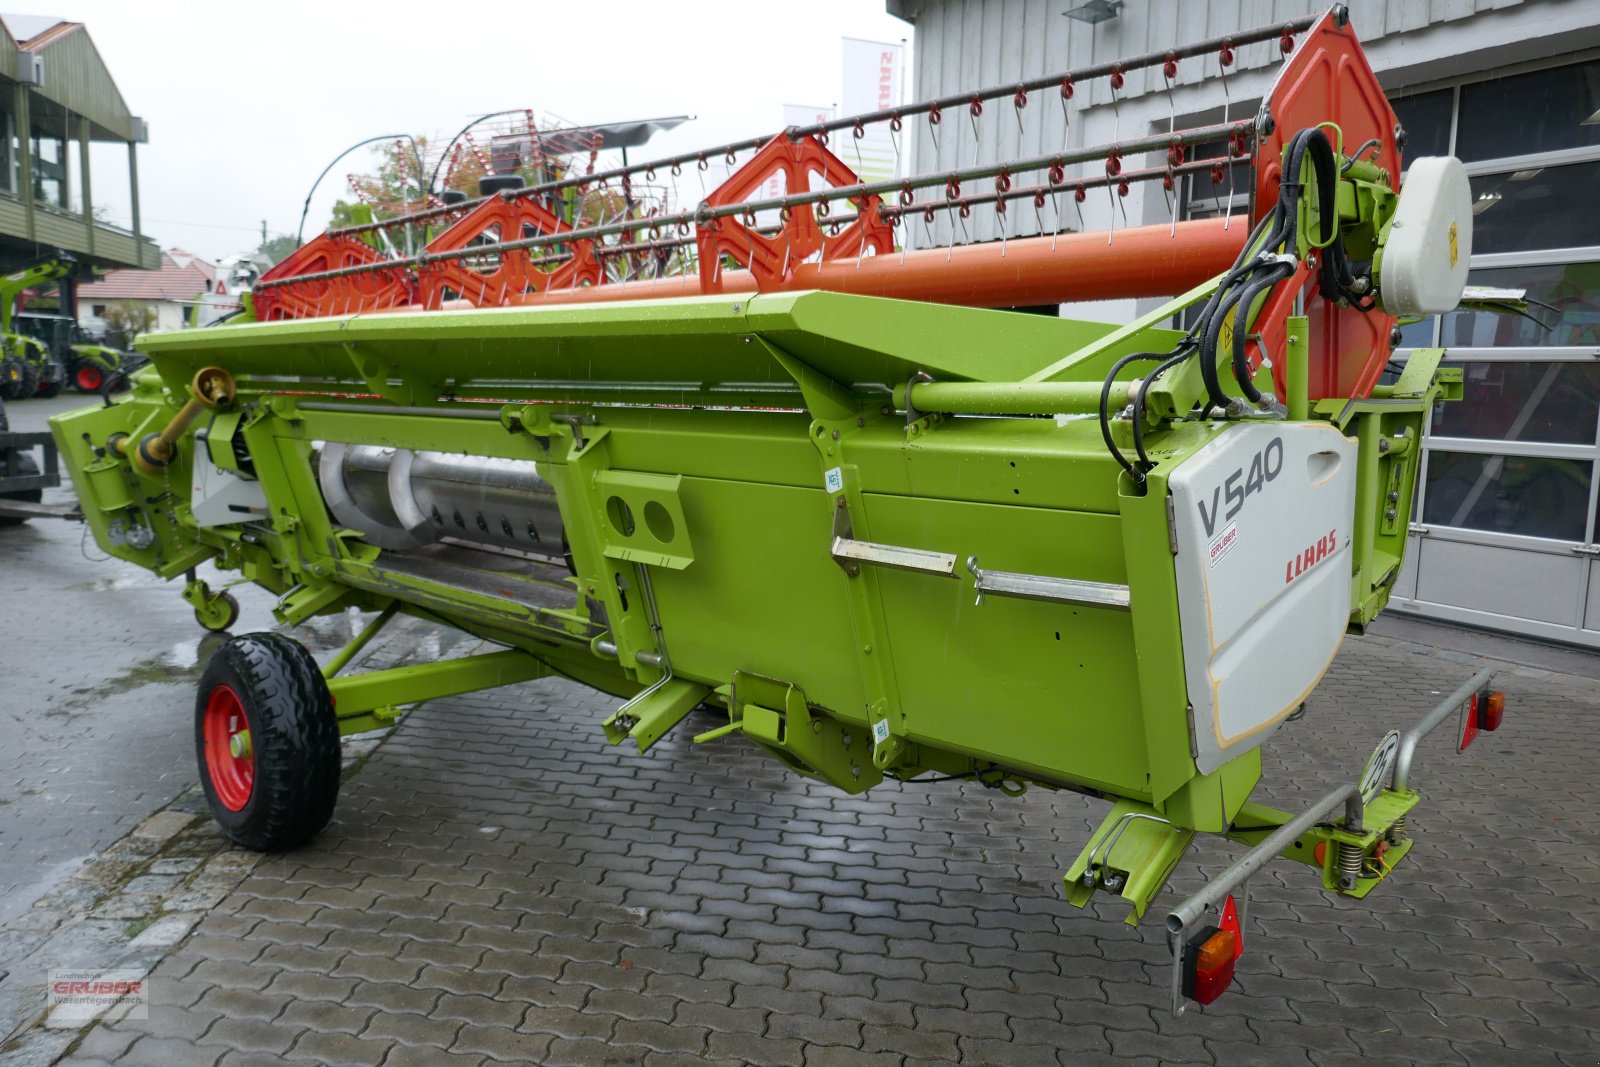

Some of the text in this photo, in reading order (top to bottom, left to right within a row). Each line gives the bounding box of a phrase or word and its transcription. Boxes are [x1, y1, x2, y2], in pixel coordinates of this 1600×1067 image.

[1197, 437, 1283, 538] V 540
[1210, 528, 1236, 557] GRUBER
[1286, 529, 1336, 583] CLAAS
[1361, 742, 1395, 796] 25
